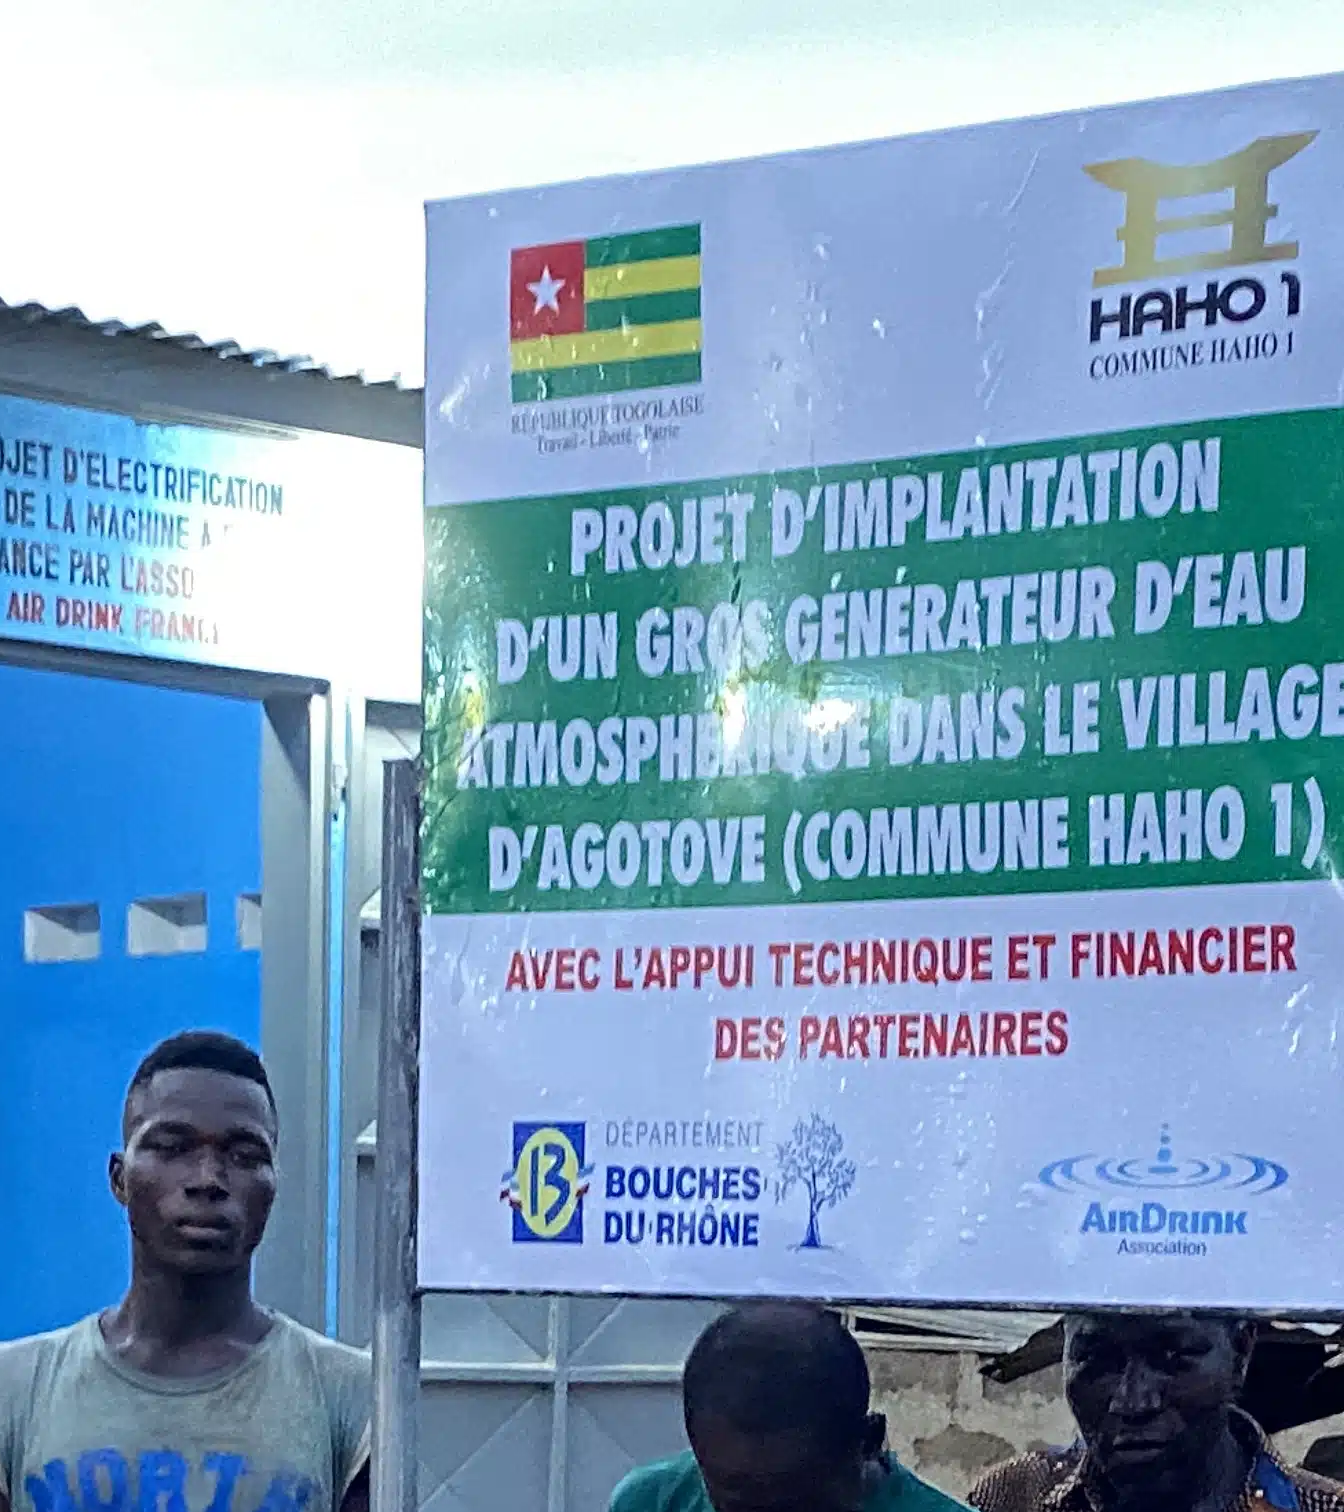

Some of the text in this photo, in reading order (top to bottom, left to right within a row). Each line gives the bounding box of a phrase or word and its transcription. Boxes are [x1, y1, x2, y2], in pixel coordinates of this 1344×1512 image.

[1089, 270, 1301, 344] HAHO 1
[1089, 331, 1294, 380] COMMUNE HAHO 1
[62, 448, 285, 517] D'ELECTRIFICATION
[570, 436, 1222, 577] PROJET D'IMPLANTATION
[3, 487, 36, 529] DE
[45, 493, 76, 535] LA
[86, 501, 190, 550] MACHINE
[68, 548, 111, 589] PAR
[6, 590, 45, 626] AIR
[56, 597, 123, 635] DRINK
[496, 546, 1307, 685] D'UN GROS GÉNÉRATEUR D'EAU
[889, 686, 1026, 767] DANS
[1044, 681, 1100, 756] LE
[488, 776, 1325, 894] D'AGOTOVE (COMMUNE HAHO 1)
[505, 924, 1297, 993] AVEC L'APPUI TECHNIQUE ET FINANCIER
[714, 1010, 1069, 1062] DES PARTENAIRES
[605, 1116, 764, 1149] DÉPARTEMENT
[530, 1143, 570, 1226] 13
[605, 1165, 761, 1202] BOUCHES
[604, 1203, 760, 1248] DU RHÔNE
